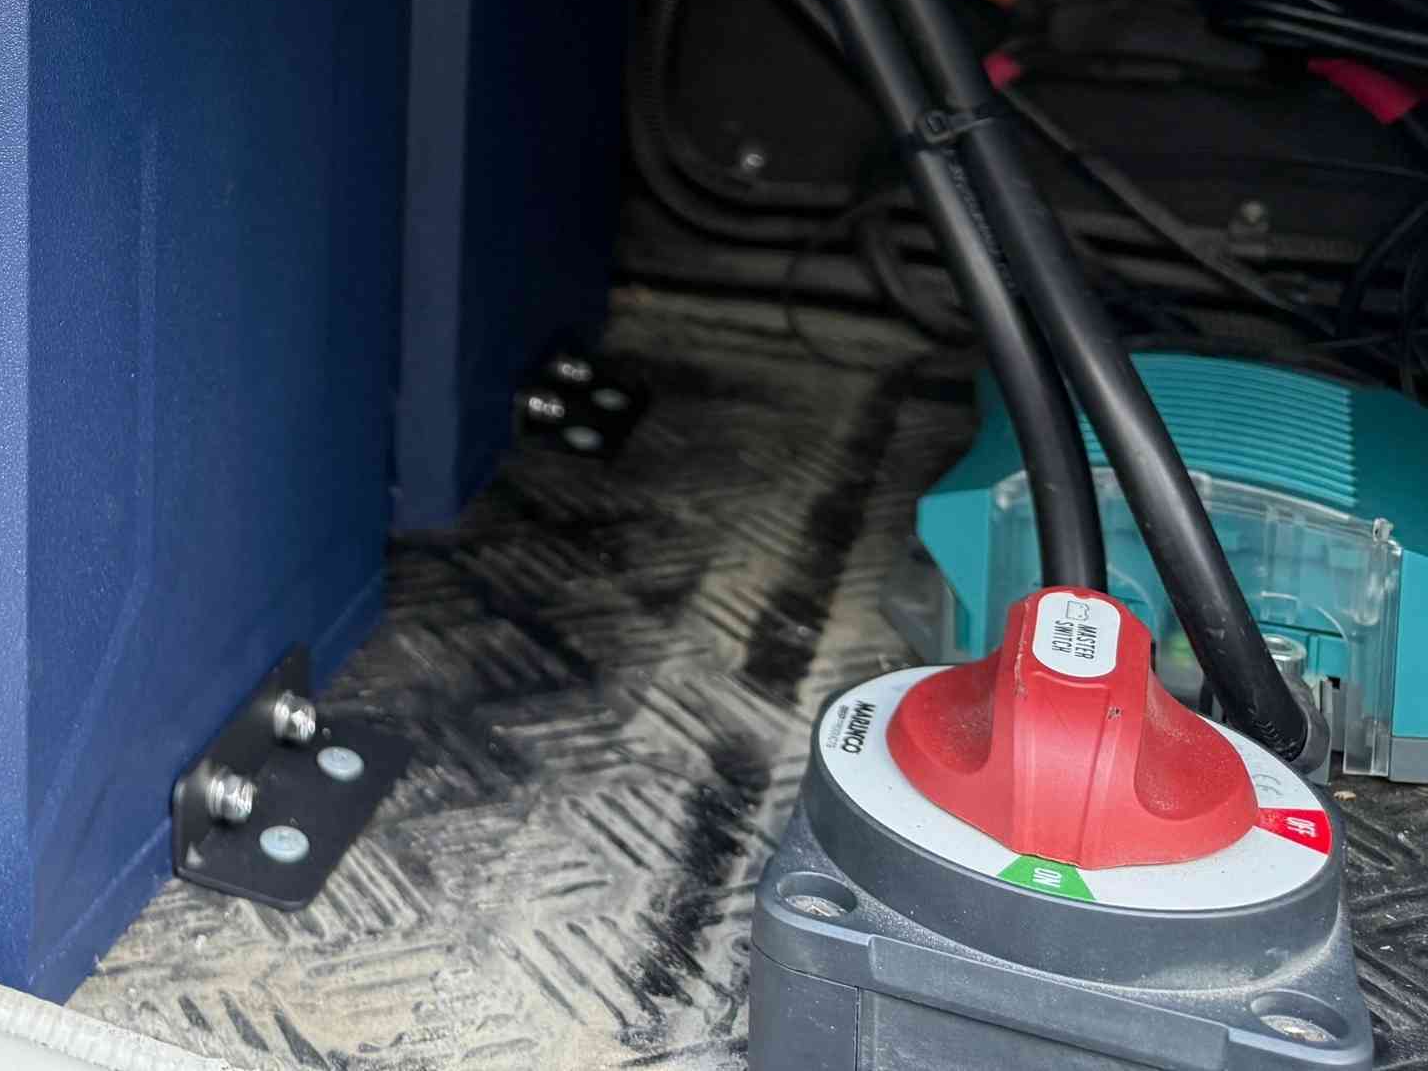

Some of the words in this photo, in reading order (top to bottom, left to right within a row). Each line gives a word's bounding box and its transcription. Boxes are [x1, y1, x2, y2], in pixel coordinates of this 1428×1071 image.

[1052, 620, 1074, 653] SWITCH
[1074, 624, 1097, 660] MASTER
[841, 700, 876, 754] MARINCO
[1286, 816, 1318, 838] OFF
[1032, 867, 1062, 887] ON
